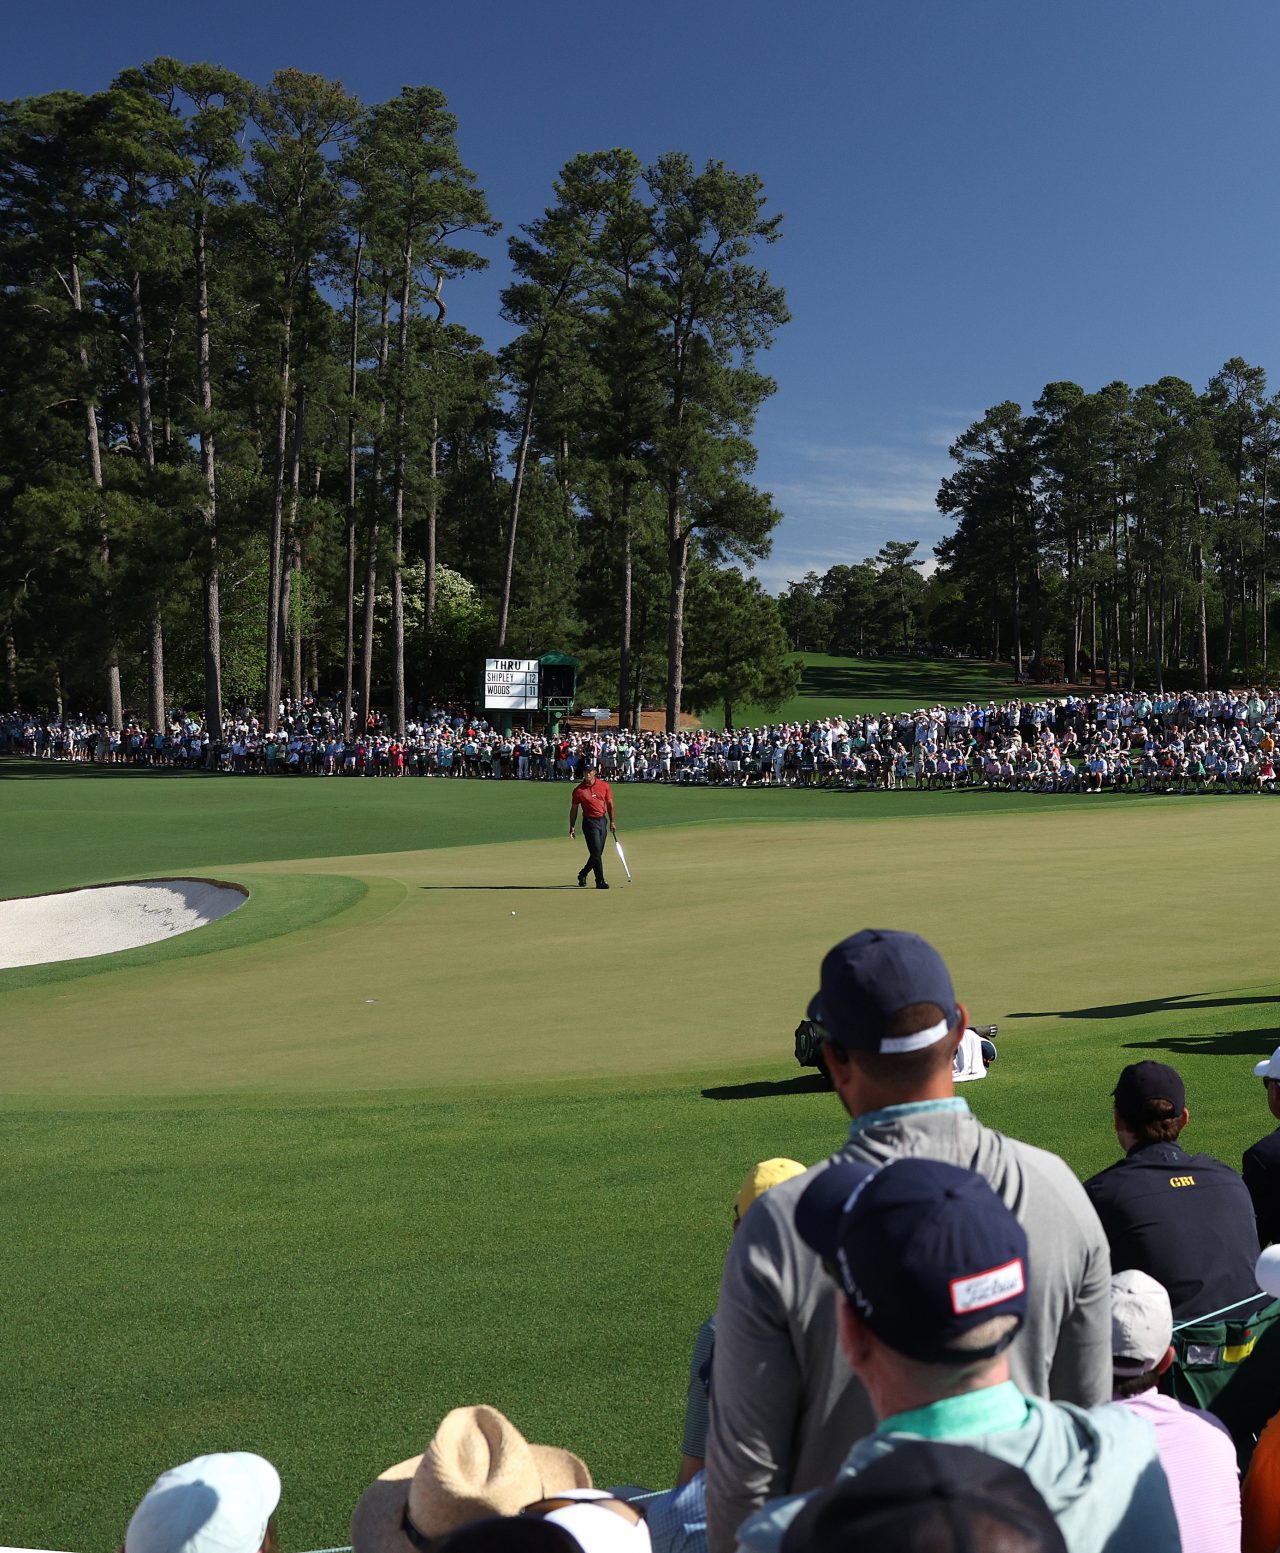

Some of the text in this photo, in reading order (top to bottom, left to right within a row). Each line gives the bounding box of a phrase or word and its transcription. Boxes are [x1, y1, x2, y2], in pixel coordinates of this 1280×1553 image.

[494, 660, 521, 670] THRU
[487, 672, 536, 684] SHIPLEY 12
[487, 685, 536, 695] WOODS 11
[1169, 1175, 1196, 1188] GBI
